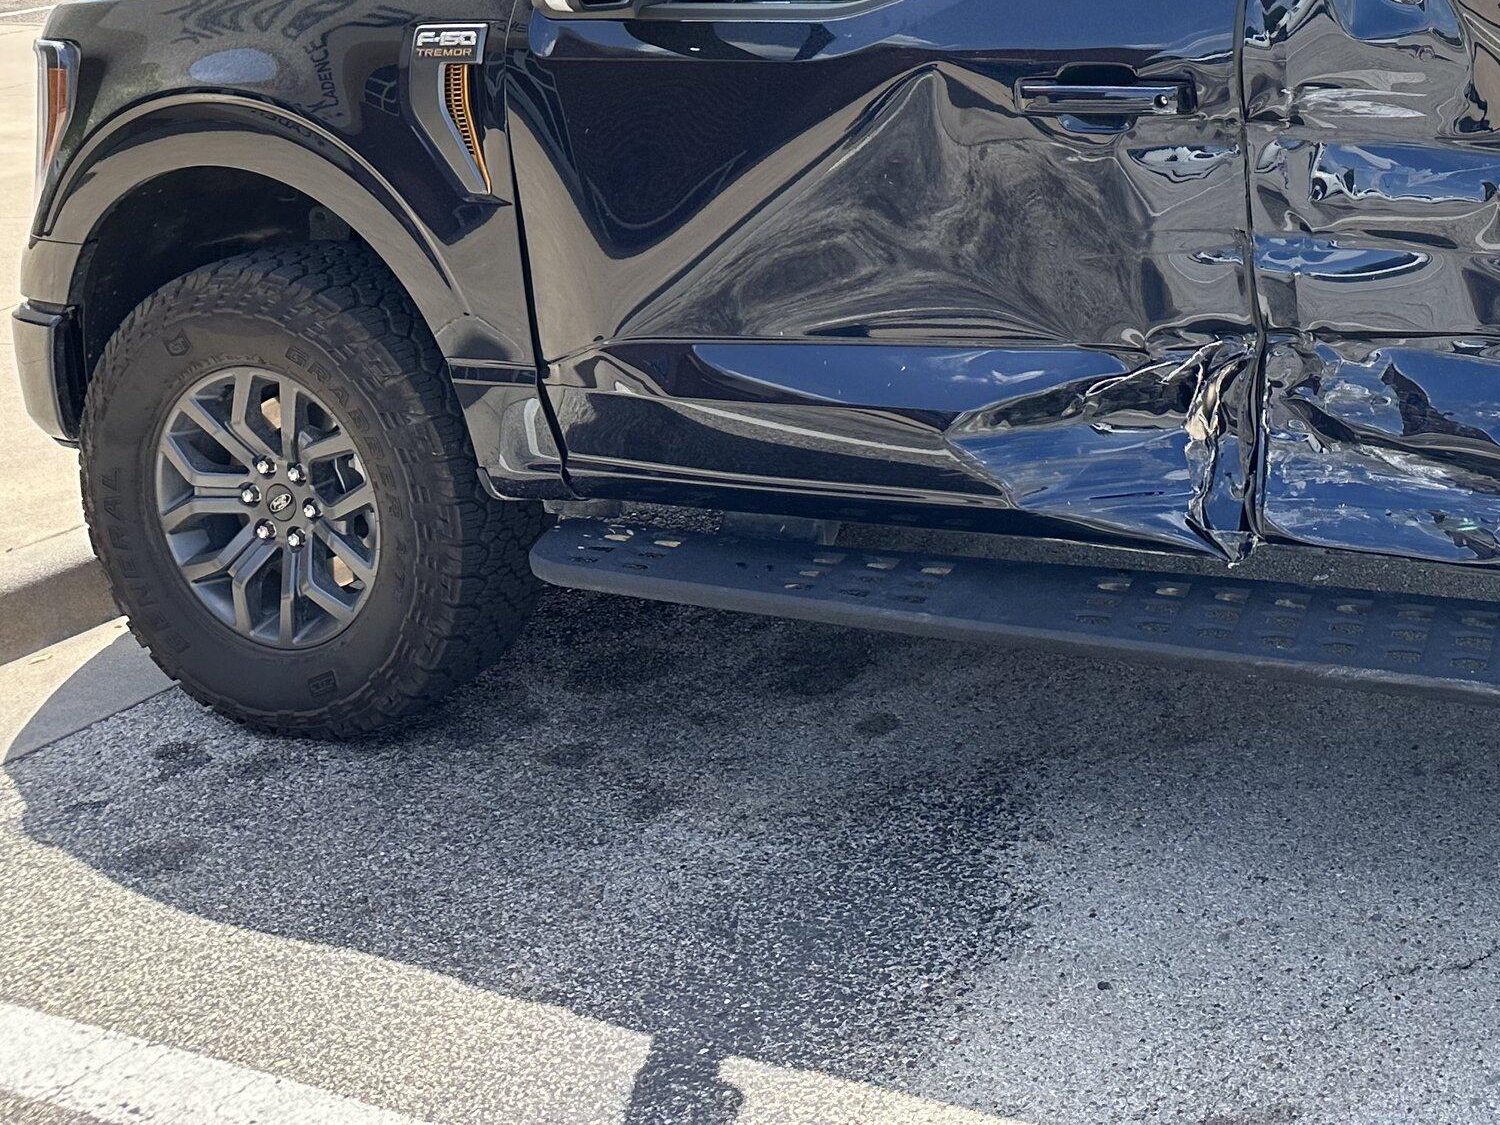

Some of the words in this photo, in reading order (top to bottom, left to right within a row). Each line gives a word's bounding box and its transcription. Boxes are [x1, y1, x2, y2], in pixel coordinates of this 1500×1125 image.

[416, 31, 478, 46] F-150
[416, 48, 472, 57] TREMOR
[101, 469, 190, 652] GENERAL
